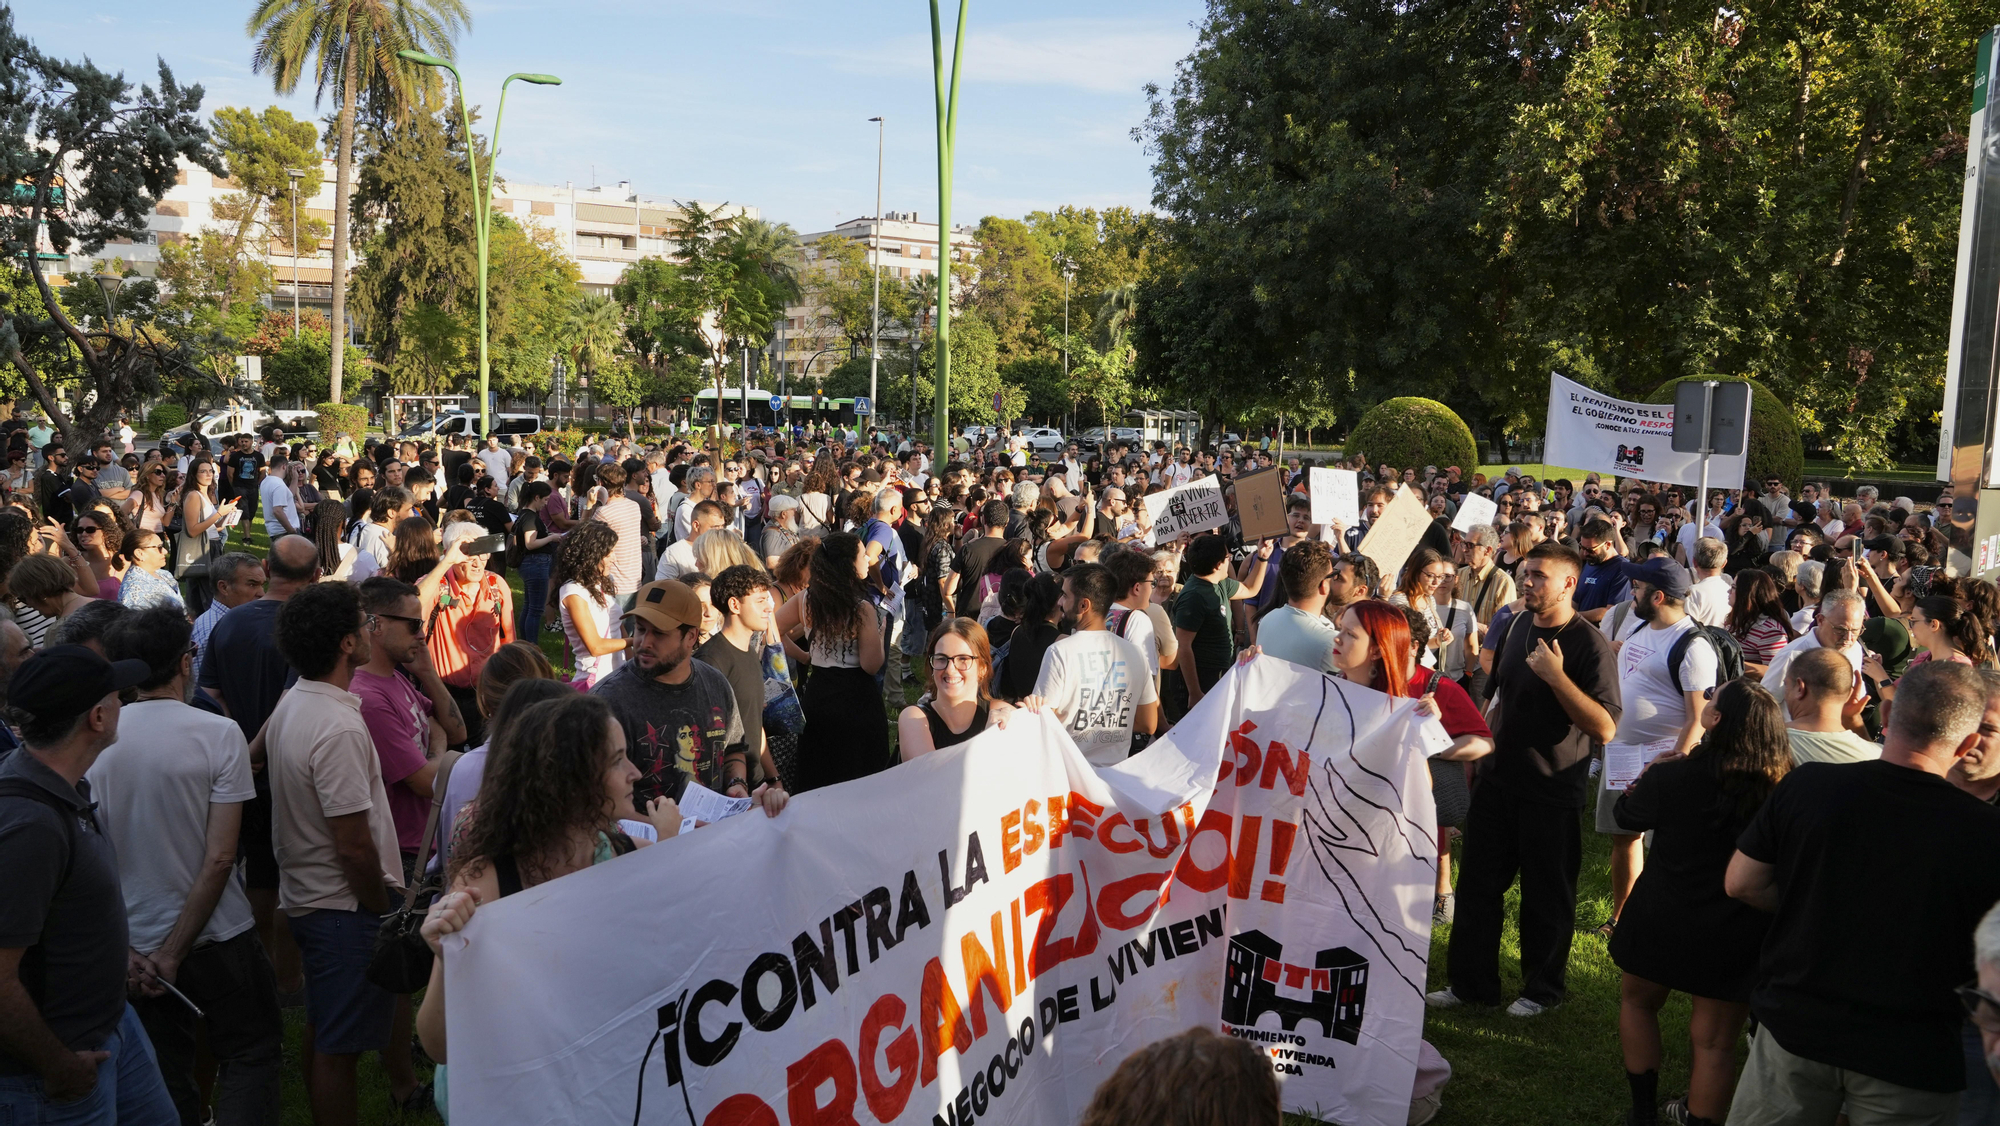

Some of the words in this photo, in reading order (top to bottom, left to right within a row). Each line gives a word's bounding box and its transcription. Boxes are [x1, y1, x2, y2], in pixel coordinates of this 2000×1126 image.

[1570, 393, 1579, 402] EL
[1582, 396, 1635, 415] RENTISMO
[1637, 409, 1650, 418] ES
[1652, 411, 1664, 419] EL
[1572, 405, 1583, 415] EL
[1585, 407, 1638, 426] GOBIERNO
[1639, 420, 1674, 430] RESPO
[1641, 429, 1673, 437] ENEMIGO
[1168, 493, 1186, 506] PARA
[1185, 482, 1216, 503] VIVIR
[1155, 515, 1170, 526] NO
[1157, 524, 1176, 537] PARA
[1176, 501, 1222, 531] INVERTIR
[1078, 650, 1111, 685] LET
[1095, 661, 1127, 690] THE
[938, 830, 989, 910] LA
[1039, 975, 1081, 1038] DE
[1107, 904, 1228, 986] VIVIEN
[1221, 1022, 1307, 1047] MOVIMIENTO
[1270, 1047, 1336, 1069] VIVIENDA
[1274, 1062, 1304, 1077] OBA
